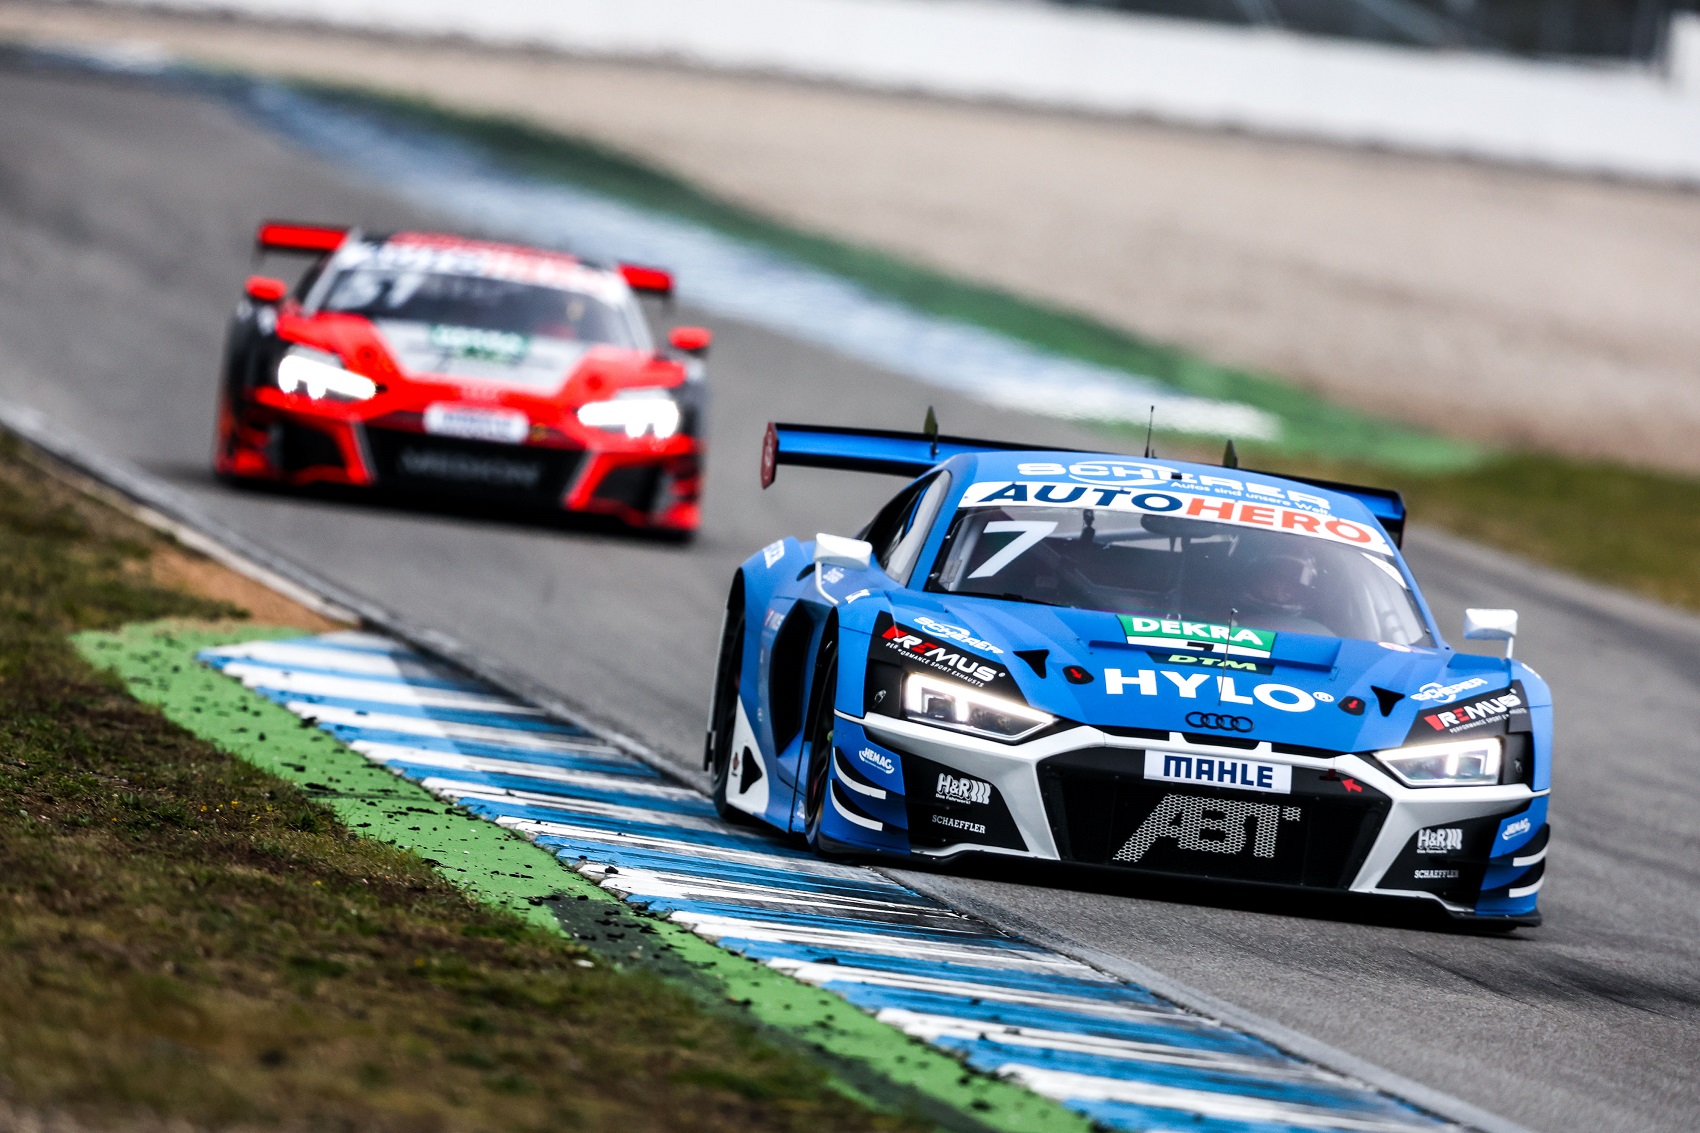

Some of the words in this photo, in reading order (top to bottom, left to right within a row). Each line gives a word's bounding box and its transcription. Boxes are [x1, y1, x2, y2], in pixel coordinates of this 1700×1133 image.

[1017, 461, 1331, 510] SCHERER
[1170, 481, 1211, 494] Autos
[1213, 486, 1242, 498] sind
[1246, 491, 1292, 506] unsere
[976, 482, 1372, 544] AUTOHERO
[967, 520, 1059, 579] 7
[1131, 617, 1263, 646] DEKRA
[892, 634, 998, 683] REMUS
[930, 660, 951, 673] SPORT
[951, 669, 985, 688] EXHAUSTS
[1168, 654, 1257, 671] DTM
[1103, 668, 1316, 713] HYLO
[1437, 692, 1522, 728] REMUS
[936, 772, 974, 800] H&R
[1163, 755, 1274, 789] MAHLE
[932, 814, 986, 835] SCHAEFFLER
[1112, 793, 1281, 862] ABT
